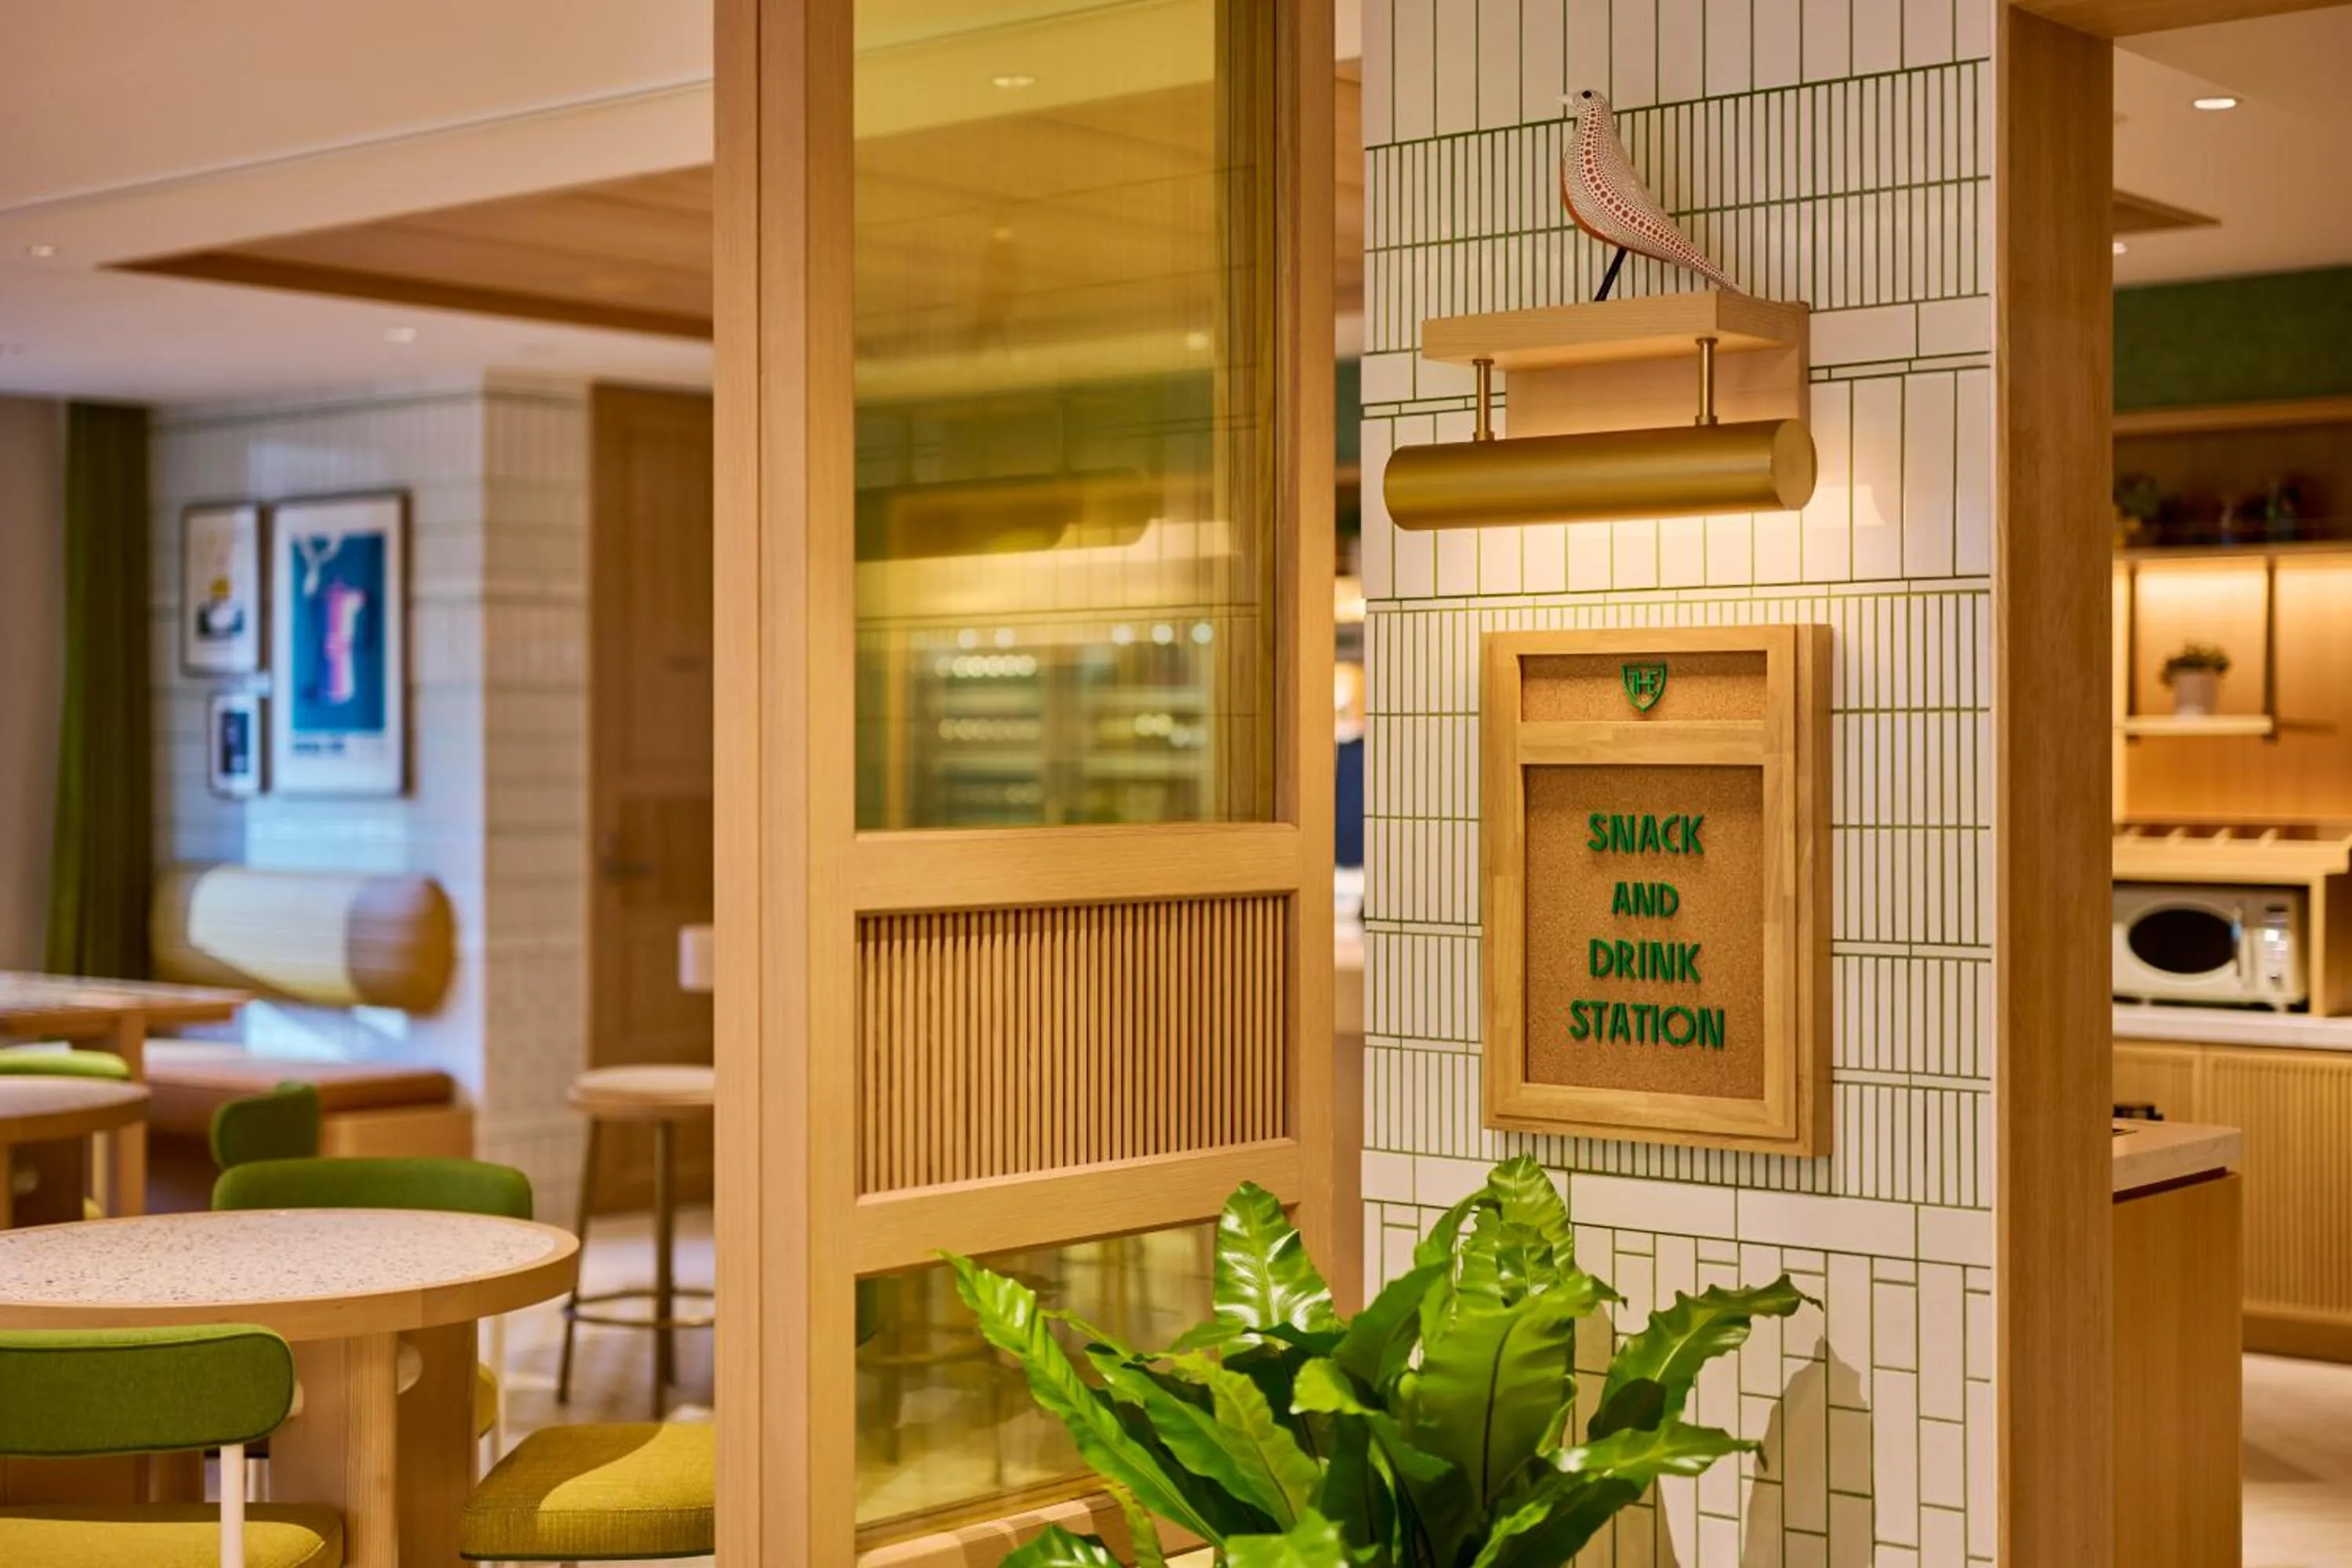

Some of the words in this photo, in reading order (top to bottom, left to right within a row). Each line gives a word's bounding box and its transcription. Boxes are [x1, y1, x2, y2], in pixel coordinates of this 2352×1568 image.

[1588, 814, 1703, 855] SNACK
[1612, 882, 1679, 917] AND
[1589, 938, 1700, 983] DRINK
[1570, 1000, 1723, 1048] STATION
